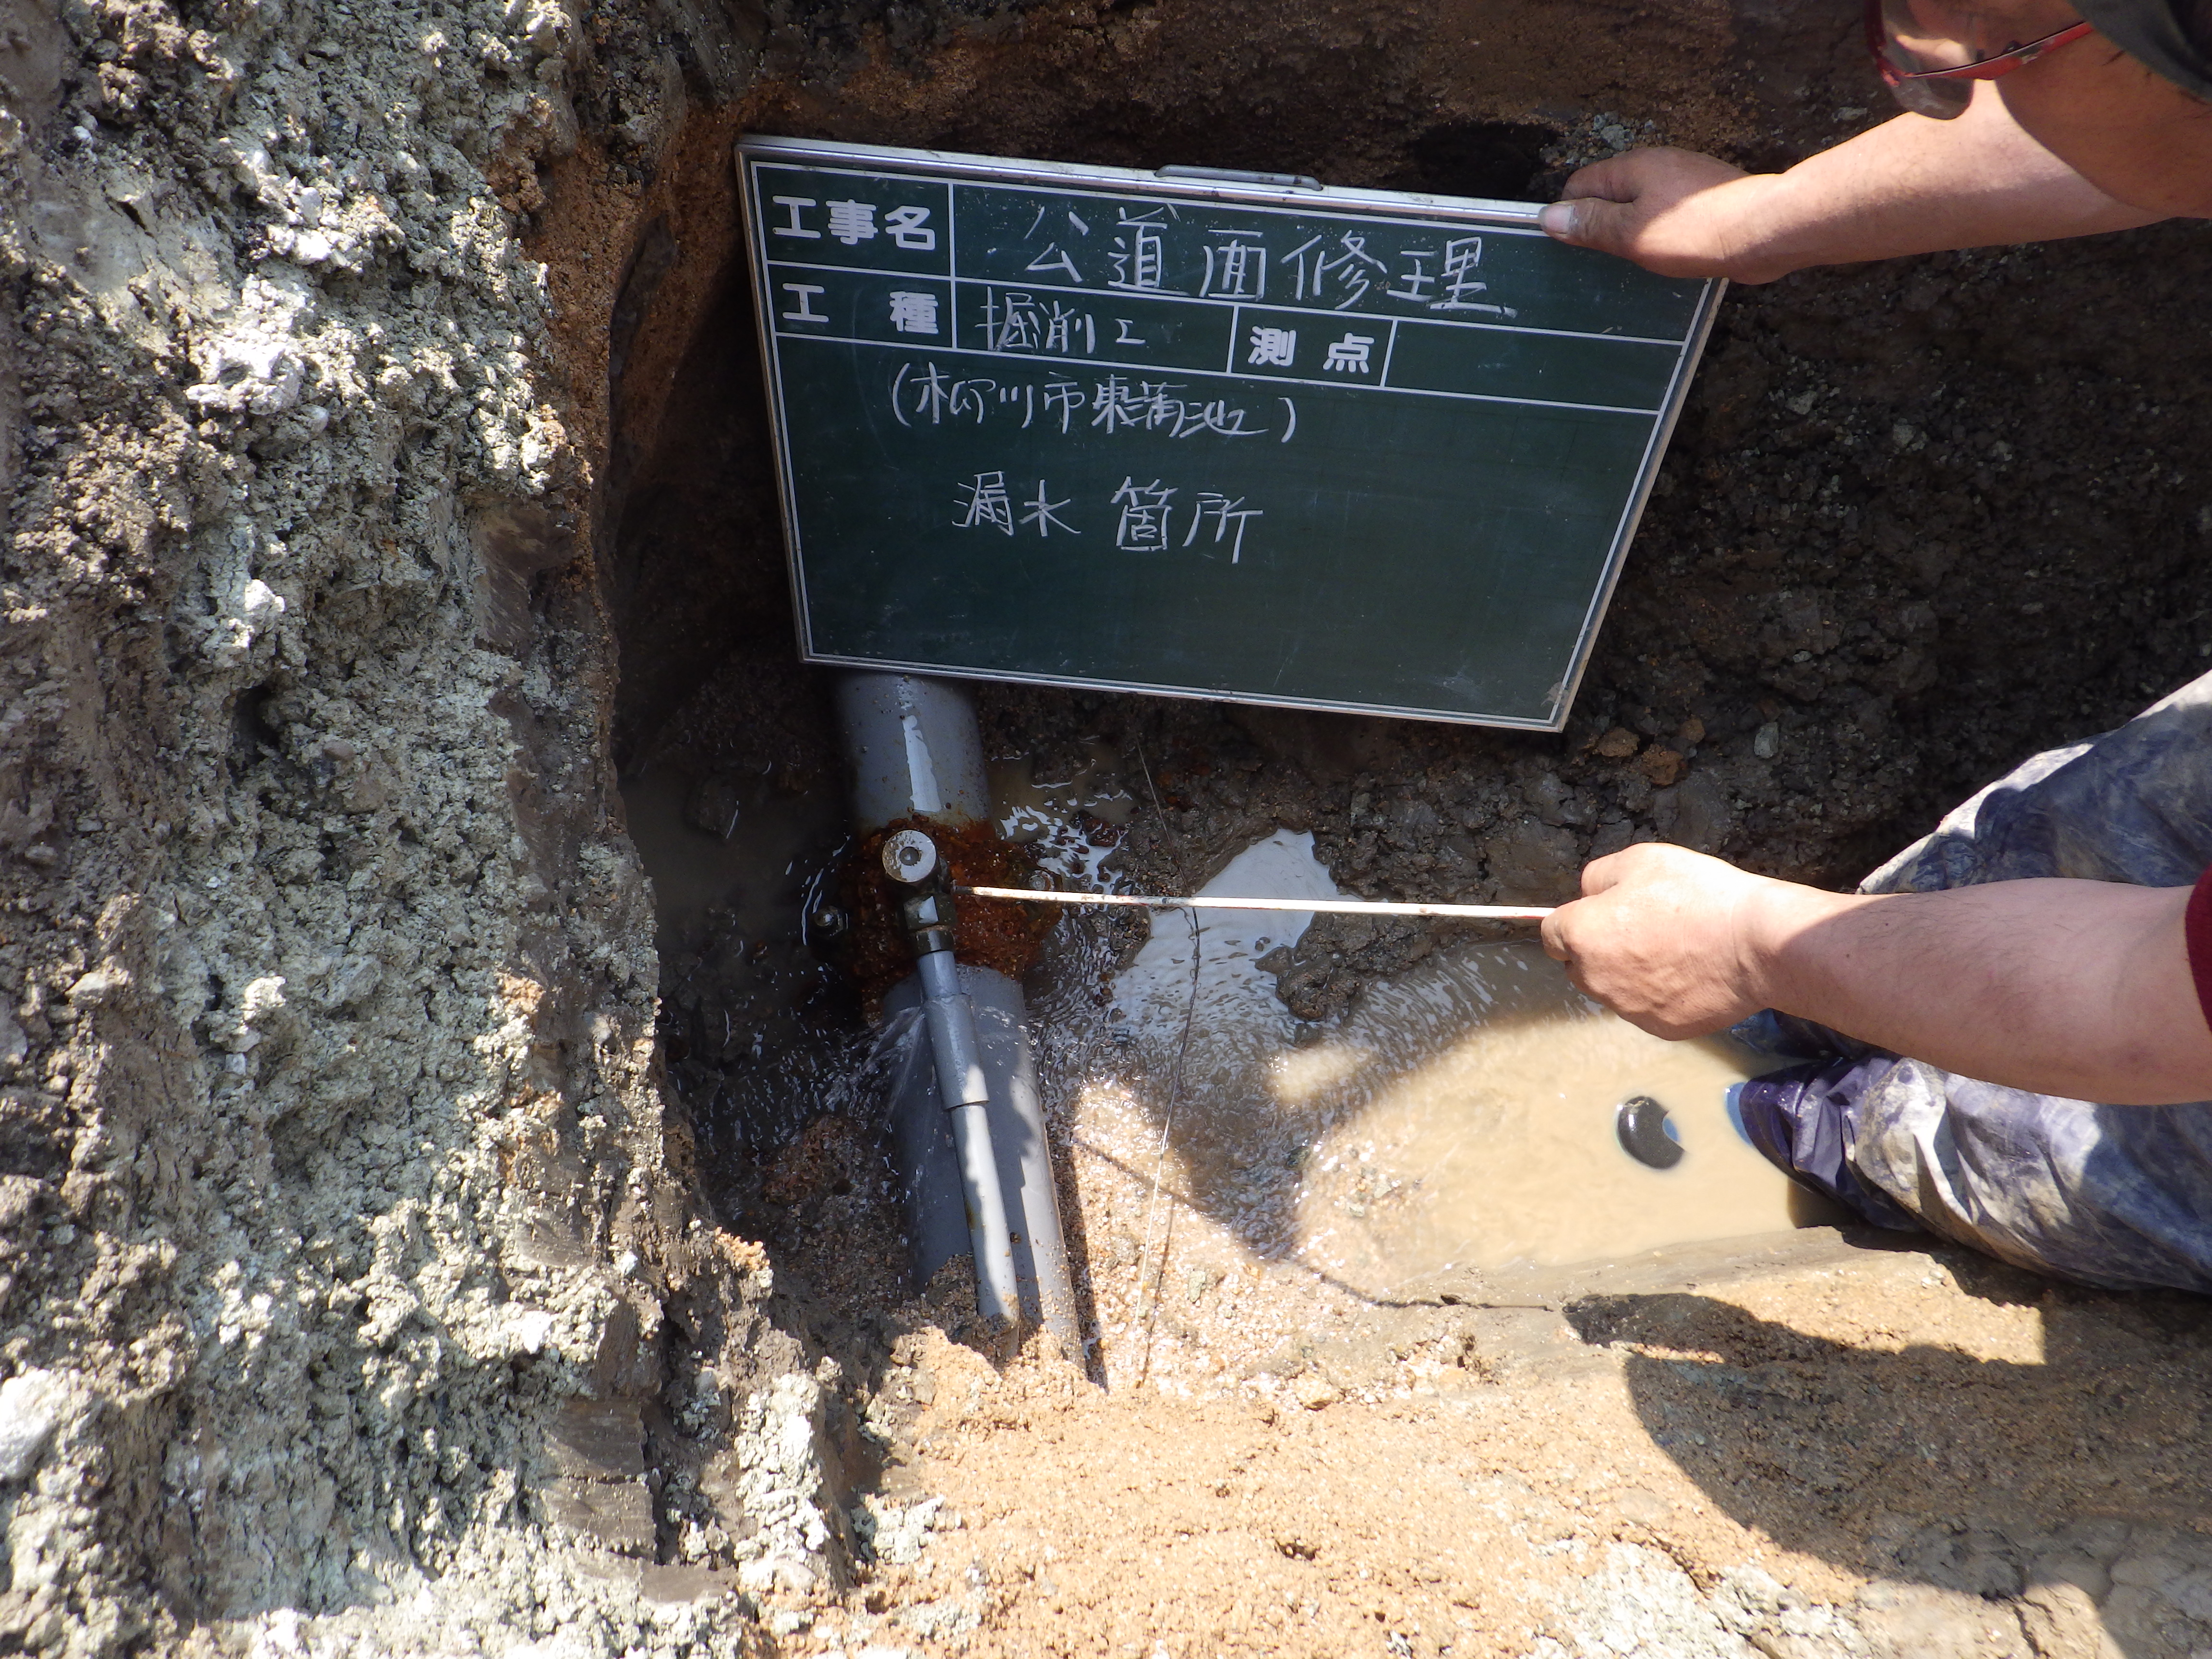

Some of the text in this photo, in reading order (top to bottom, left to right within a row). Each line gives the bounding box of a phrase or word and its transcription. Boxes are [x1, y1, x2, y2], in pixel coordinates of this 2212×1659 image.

[772, 195, 937, 251] 工事名
[1024, 202, 1518, 317] 公道面修理
[781, 282, 939, 334] 工種
[1247, 325, 1375, 374] 測点
